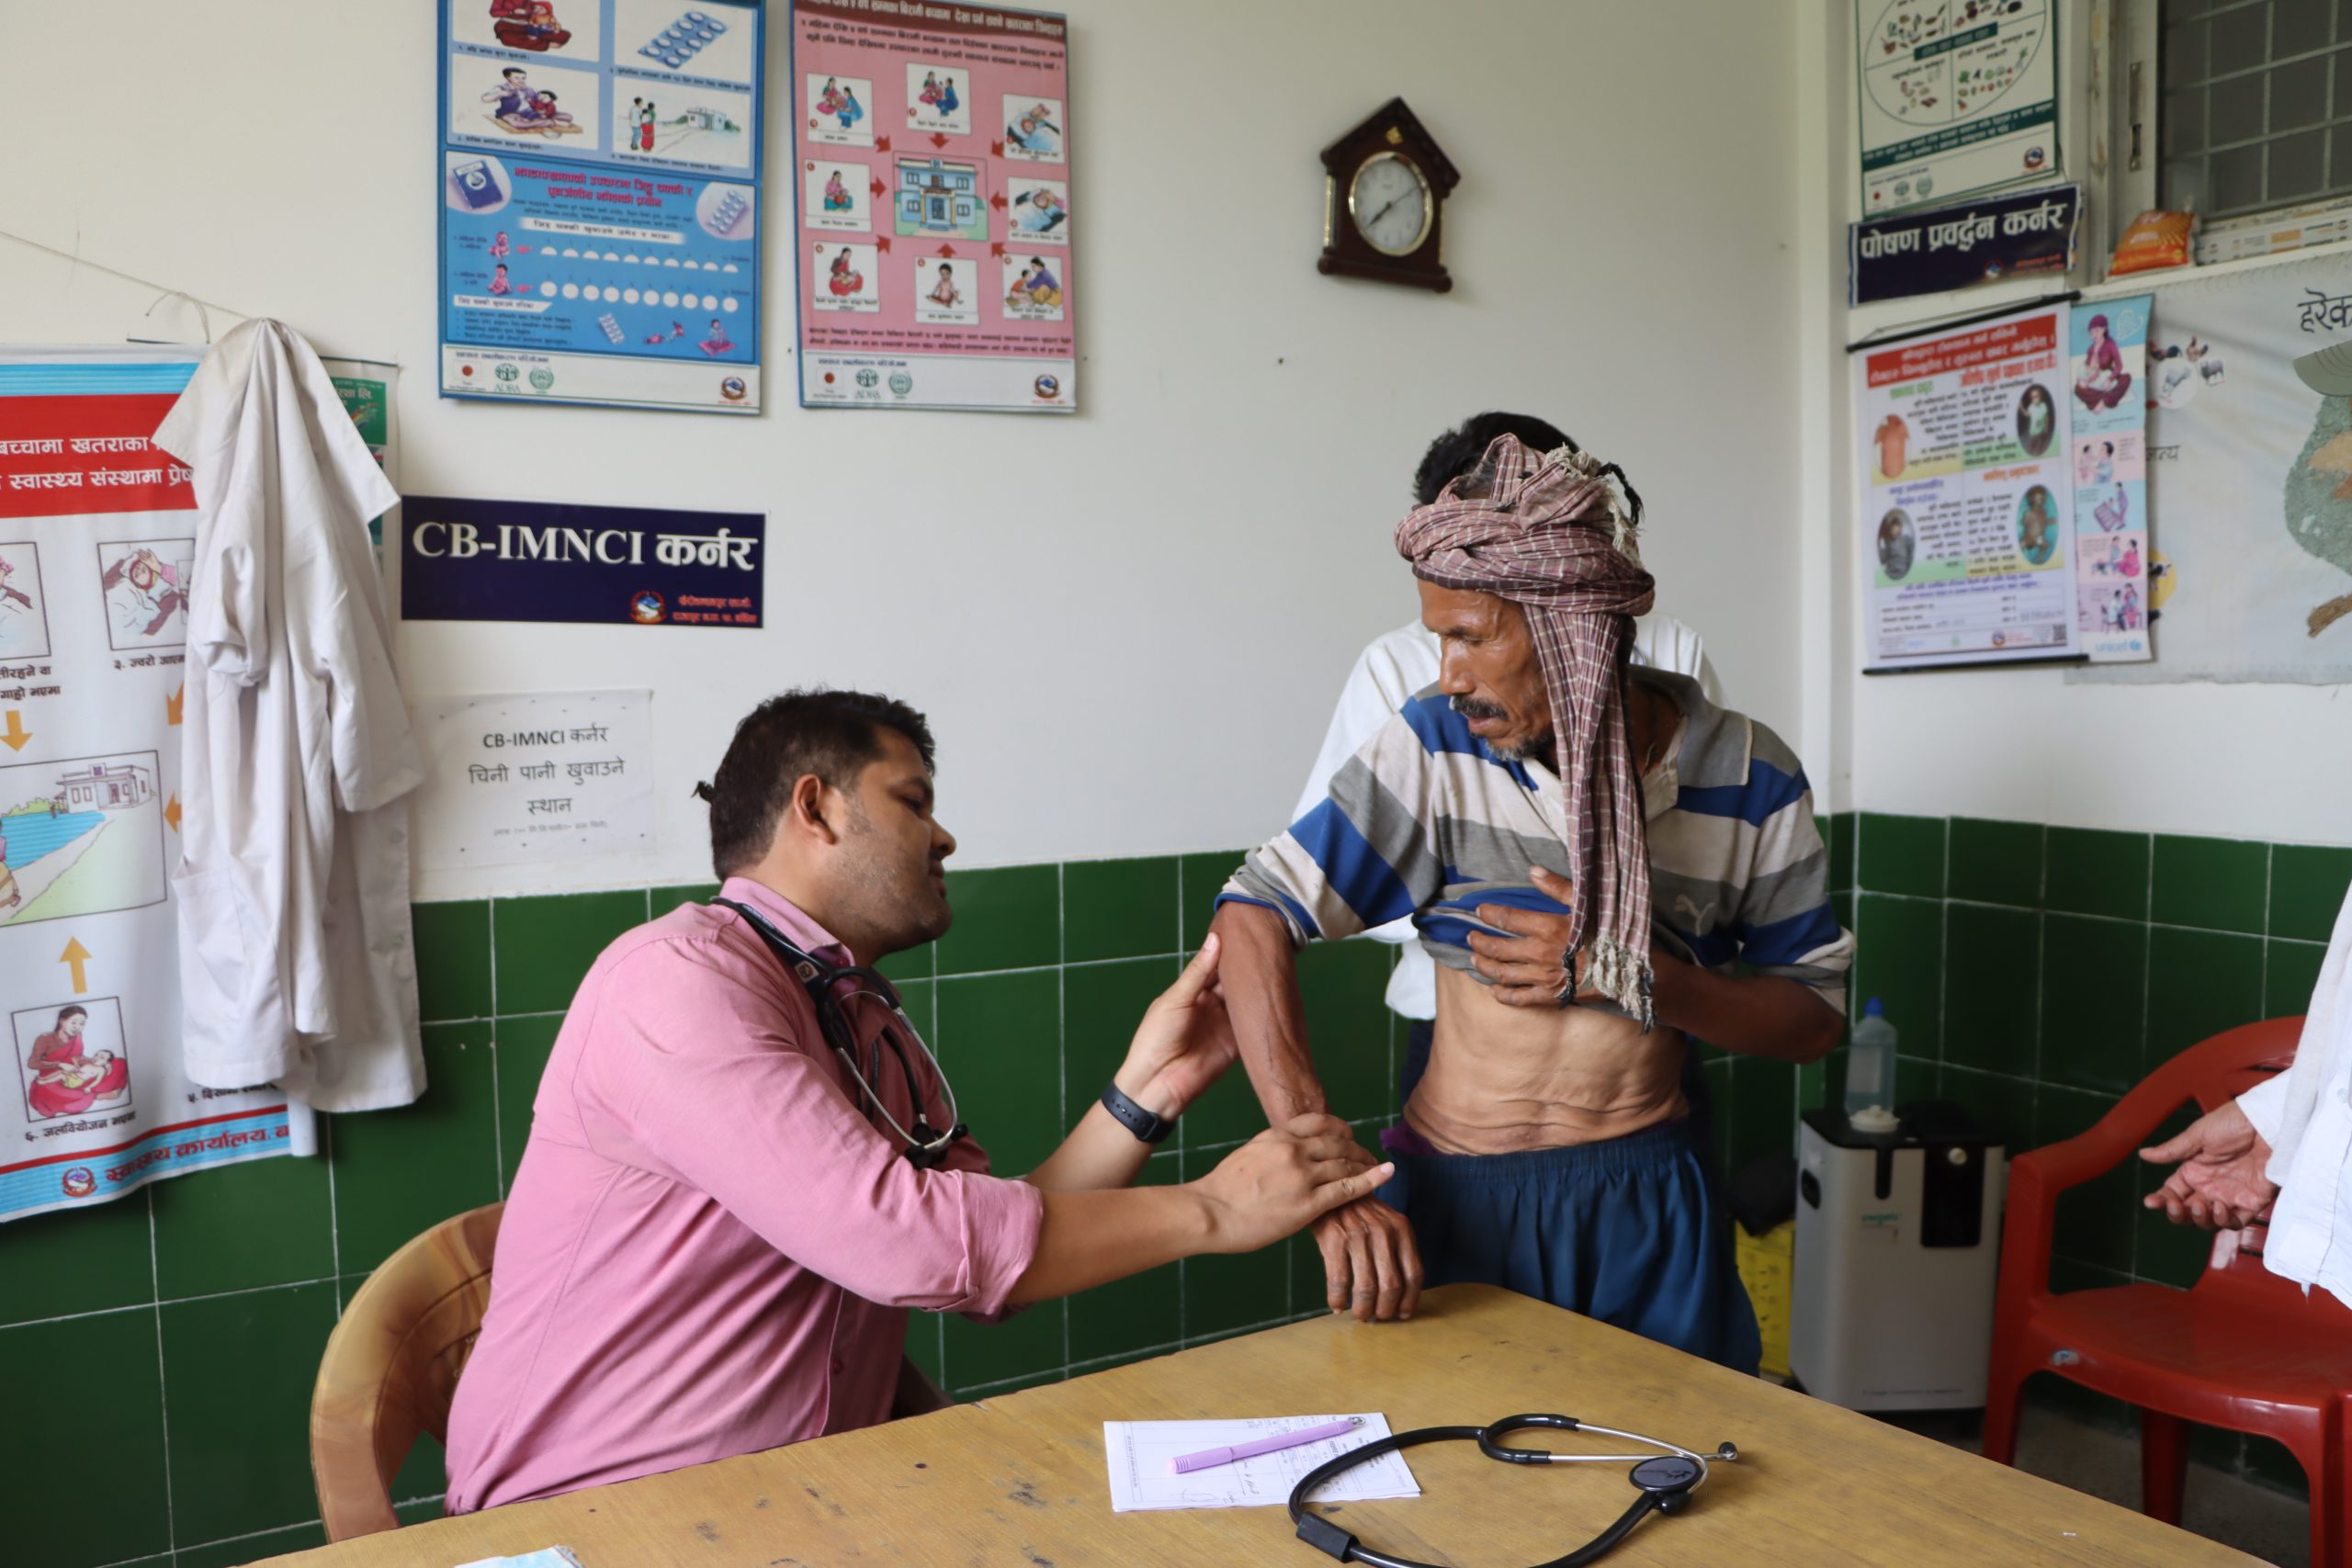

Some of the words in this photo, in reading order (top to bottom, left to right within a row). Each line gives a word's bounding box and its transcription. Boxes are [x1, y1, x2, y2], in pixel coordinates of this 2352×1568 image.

[1860, 229, 1922, 259] पोषण
[2003, 199, 2068, 236] कर्नर
[70, 437, 149, 454] खतराका
[9, 471, 84, 491] स्वास्थ्य
[89, 467, 164, 487] संस्थामा
[168, 464, 193, 487] प्रेष
[413, 521, 646, 565] CB-IMNCI
[656, 527, 758, 570] कर्नर
[482, 730, 565, 749] CB-IMNCI
[570, 722, 609, 743] कर्नर
[469, 762, 509, 784] चिनी
[520, 760, 556, 780] पानी
[566, 755, 626, 786] खुवाउने
[526, 797, 572, 815] स्थान
[42, 1119, 108, 1137] जलवियोजन
[105, 1146, 171, 1182] स्वास्थ्य
